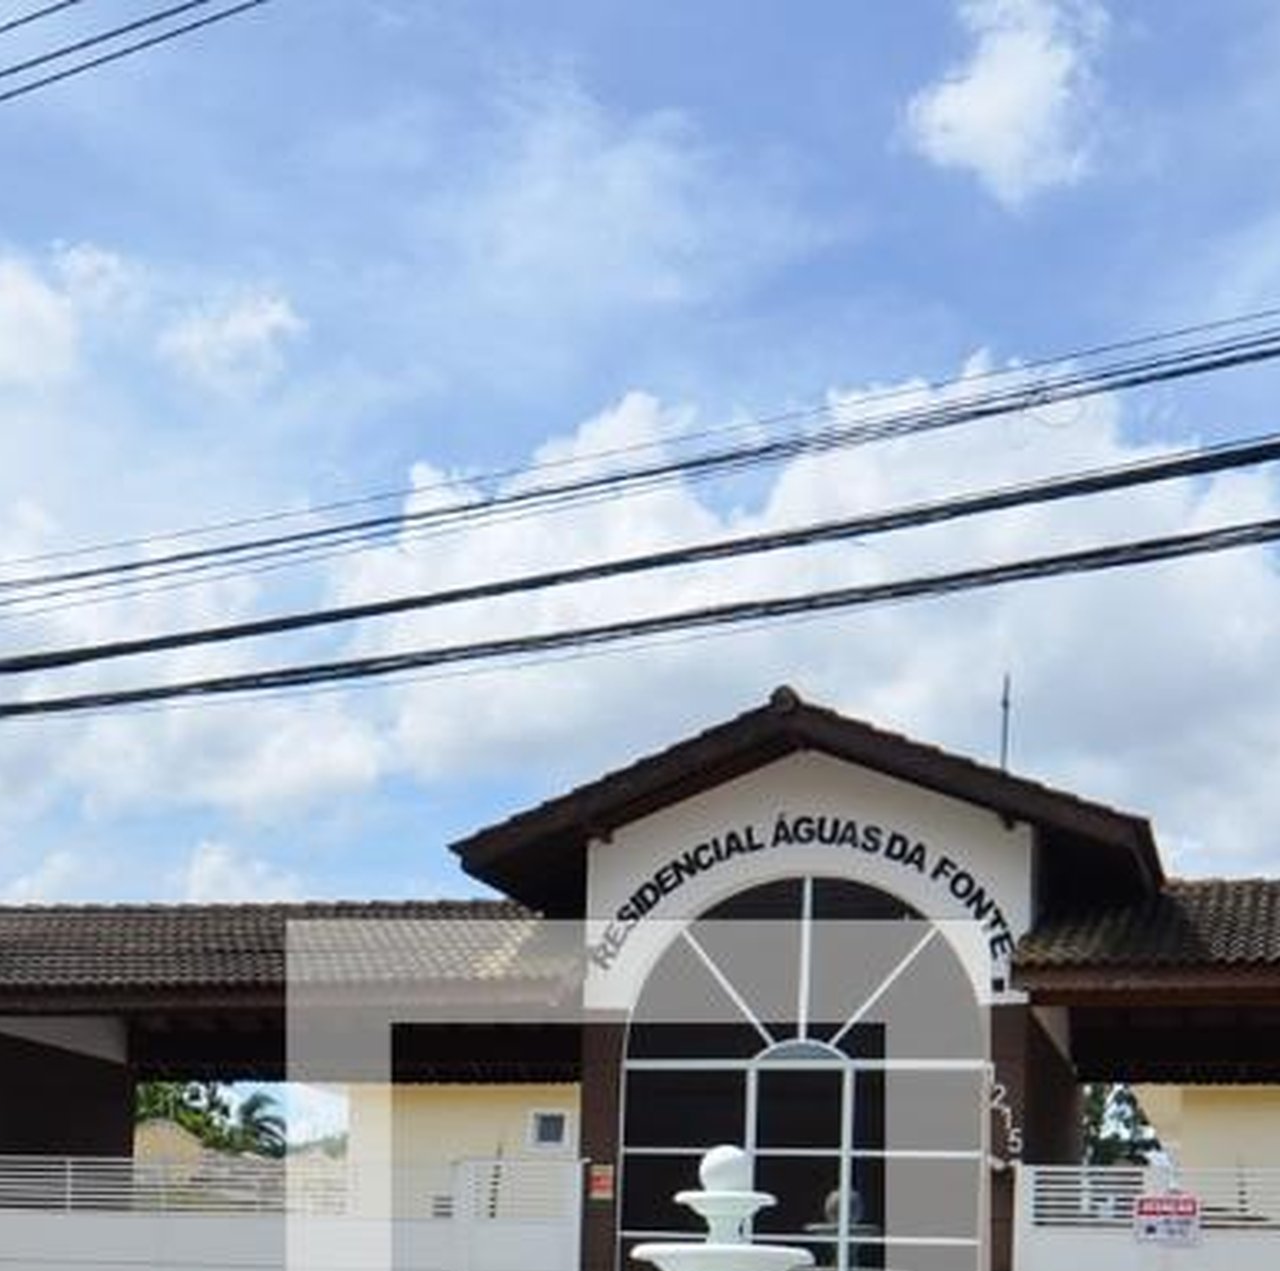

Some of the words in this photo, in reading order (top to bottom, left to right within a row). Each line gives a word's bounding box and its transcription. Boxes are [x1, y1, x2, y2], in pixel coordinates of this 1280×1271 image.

[592, 825, 765, 971] RESIDENCIAL
[771, 812, 883, 854] ÁGUAS
[884, 831, 926, 873] DA
[931, 856, 1016, 960] FONTE
